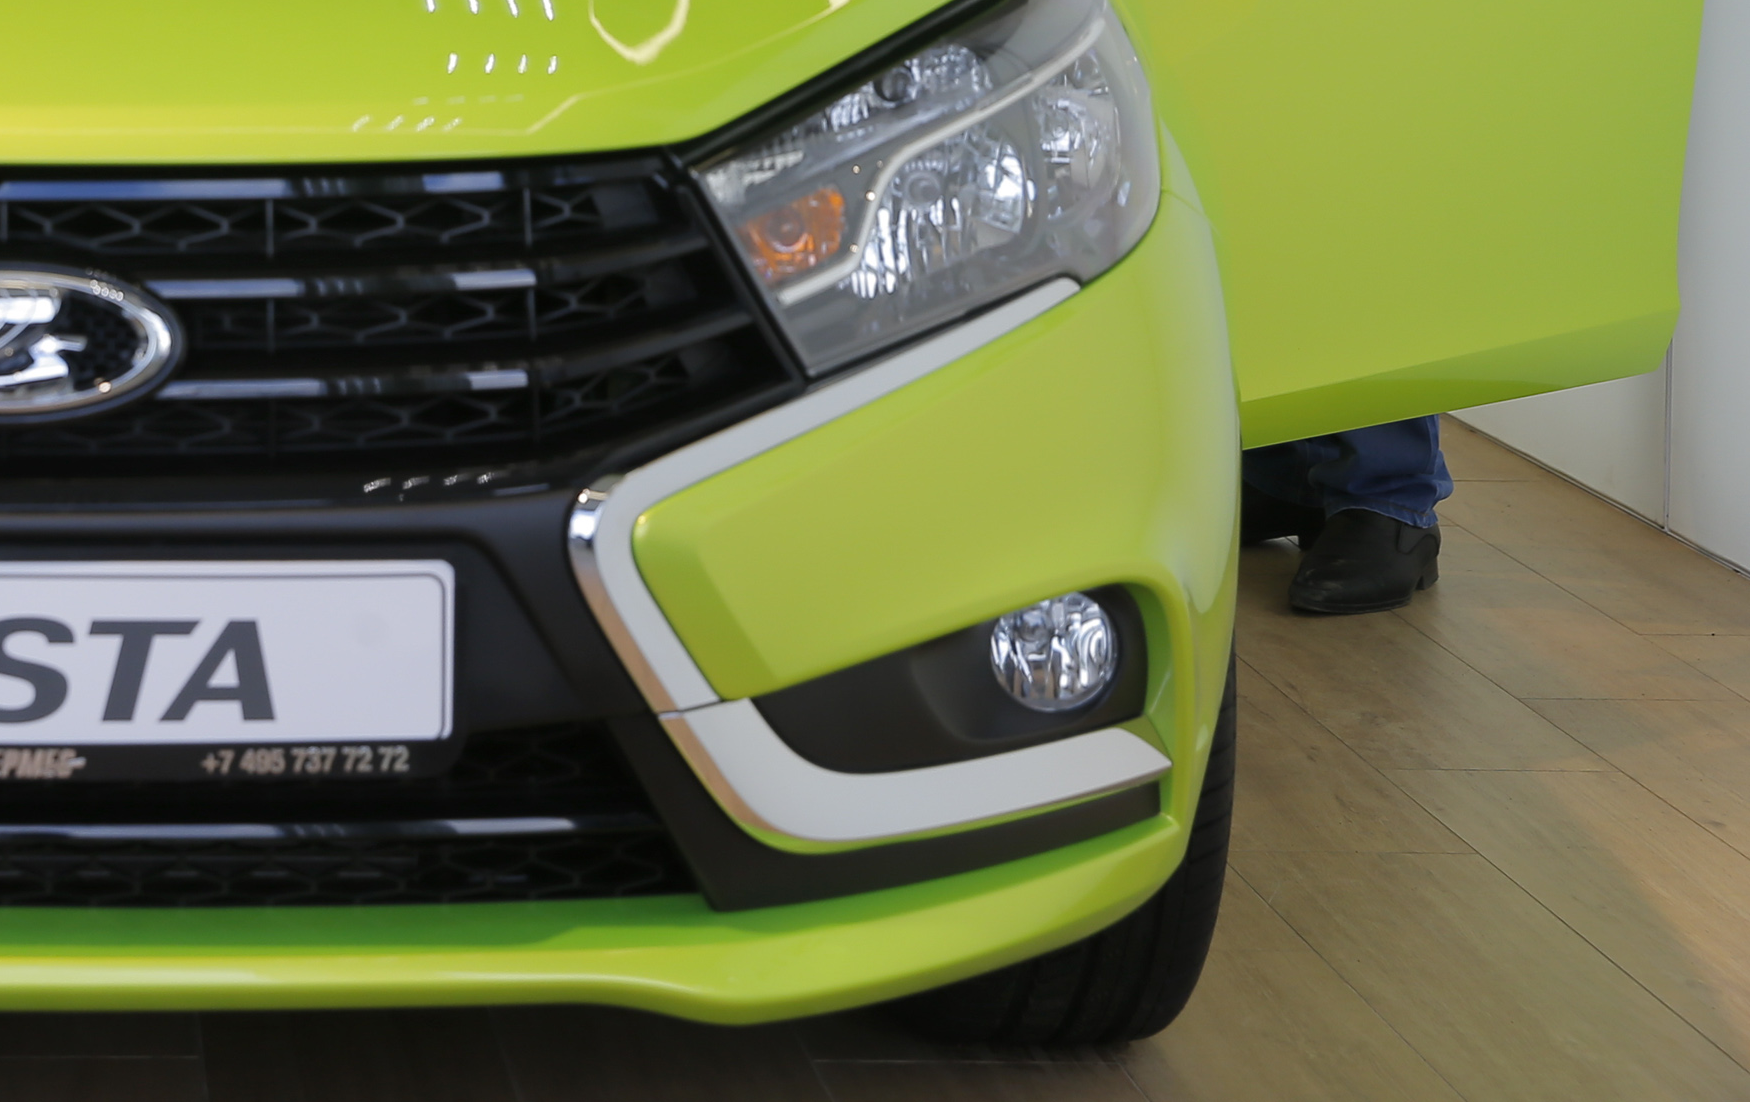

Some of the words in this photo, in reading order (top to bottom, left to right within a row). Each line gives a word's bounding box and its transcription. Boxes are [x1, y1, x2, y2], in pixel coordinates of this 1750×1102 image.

[201, 749, 235, 774] +7
[239, 748, 286, 775] 495
[290, 746, 338, 774] 737
[341, 745, 373, 773] 72
[377, 744, 410, 773] 72
